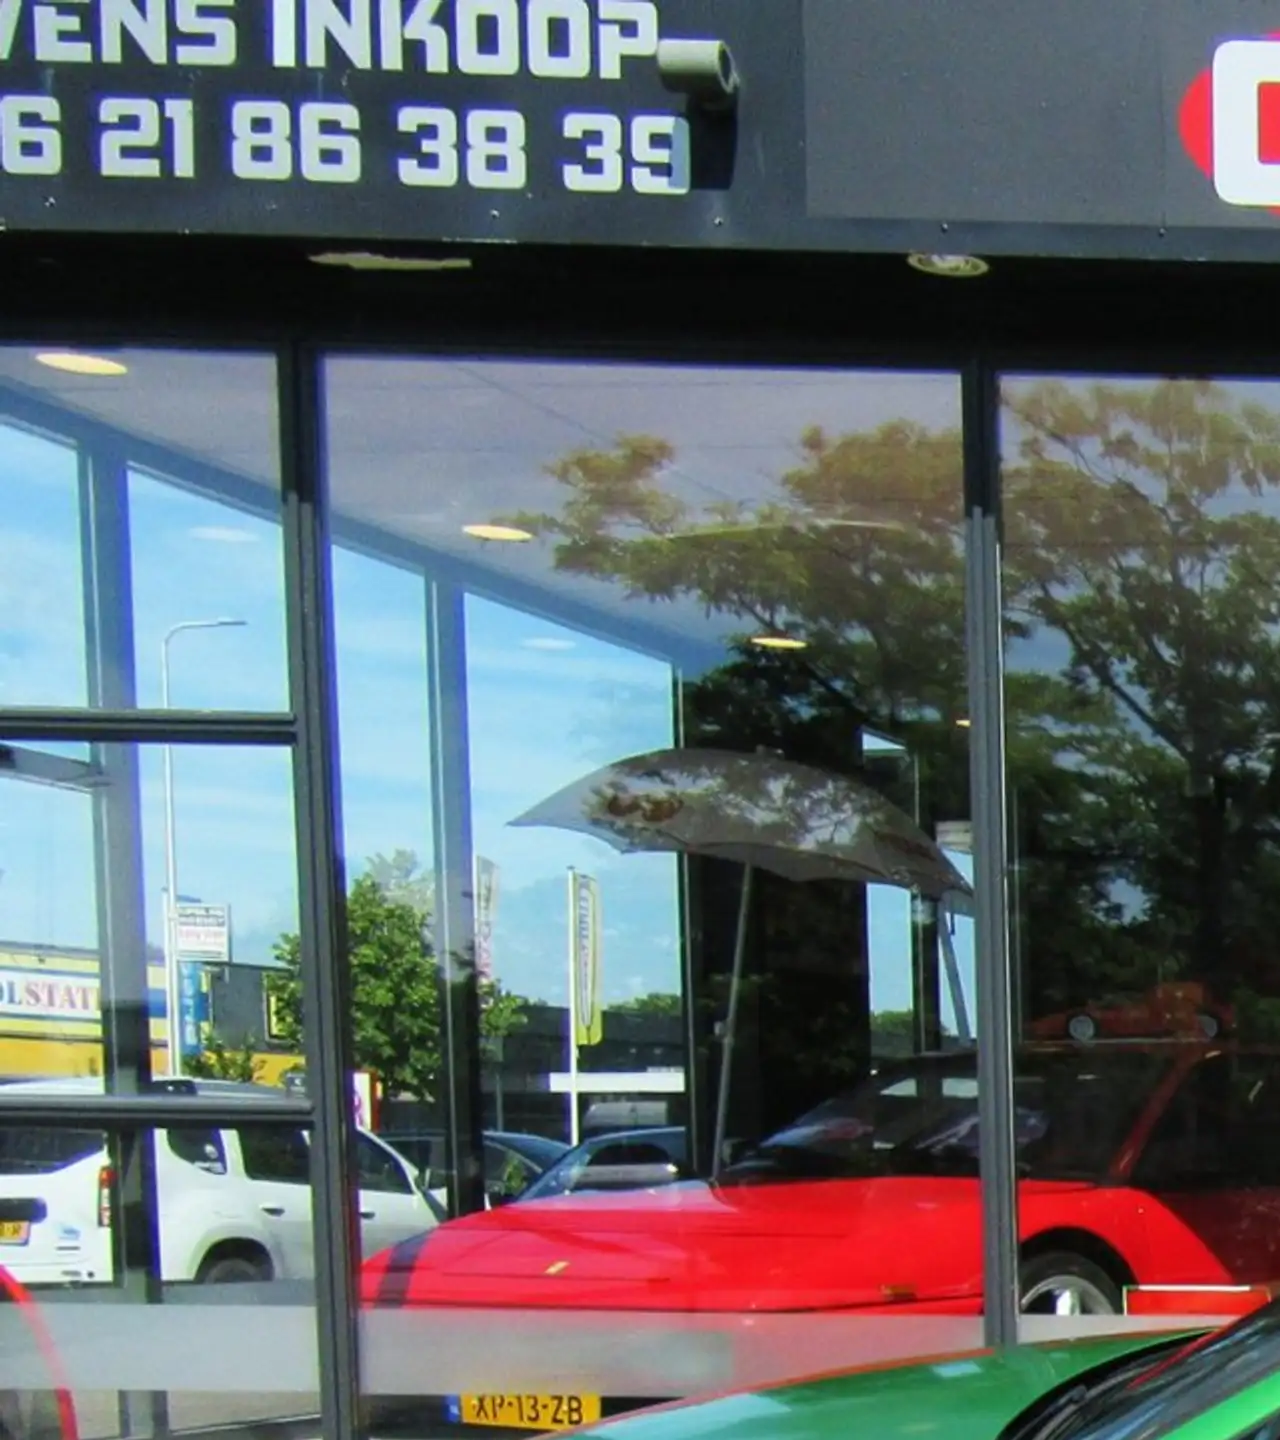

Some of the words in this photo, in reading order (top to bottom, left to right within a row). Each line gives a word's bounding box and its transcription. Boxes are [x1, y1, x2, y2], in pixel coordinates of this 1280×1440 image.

[272, 0, 661, 79] INKOOP
[99, 98, 194, 178] 21
[232, 101, 361, 183] 86
[398, 106, 526, 189] 38
[563, 113, 690, 194] 39
